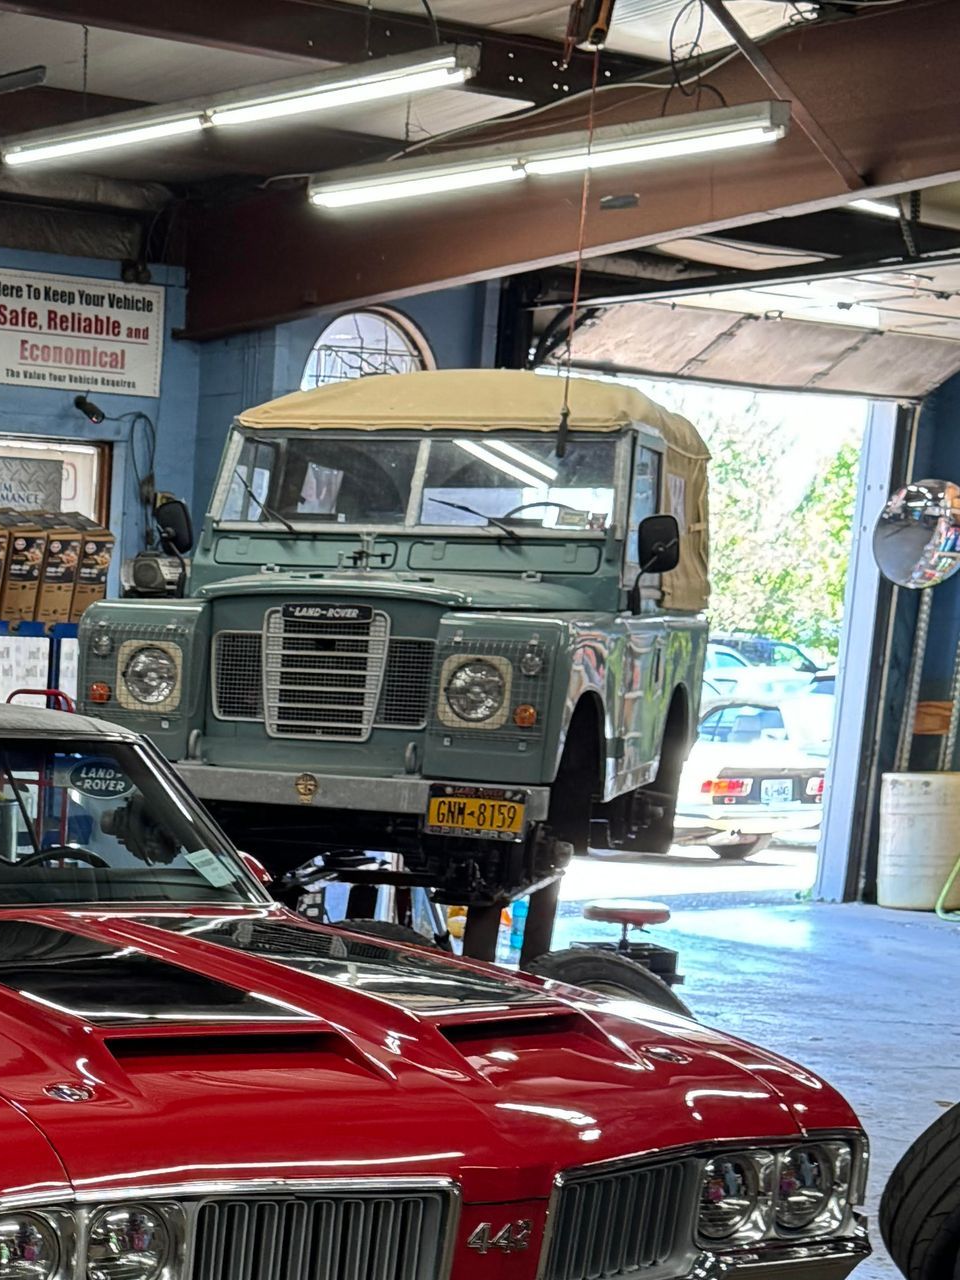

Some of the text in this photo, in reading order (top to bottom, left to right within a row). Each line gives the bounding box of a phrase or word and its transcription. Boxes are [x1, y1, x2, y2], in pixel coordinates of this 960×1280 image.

[26, 284, 41, 300] To
[44, 286, 76, 306] Keep
[78, 289, 105, 308] Your
[108, 293, 153, 313] Vehicle
[47, 310, 121, 337] Reliable
[126, 326, 149, 340] and
[19, 339, 125, 369] Economical
[5, 368, 136, 389] The Value Your Vehicle Requires
[466, 1218, 534, 1255] 442
